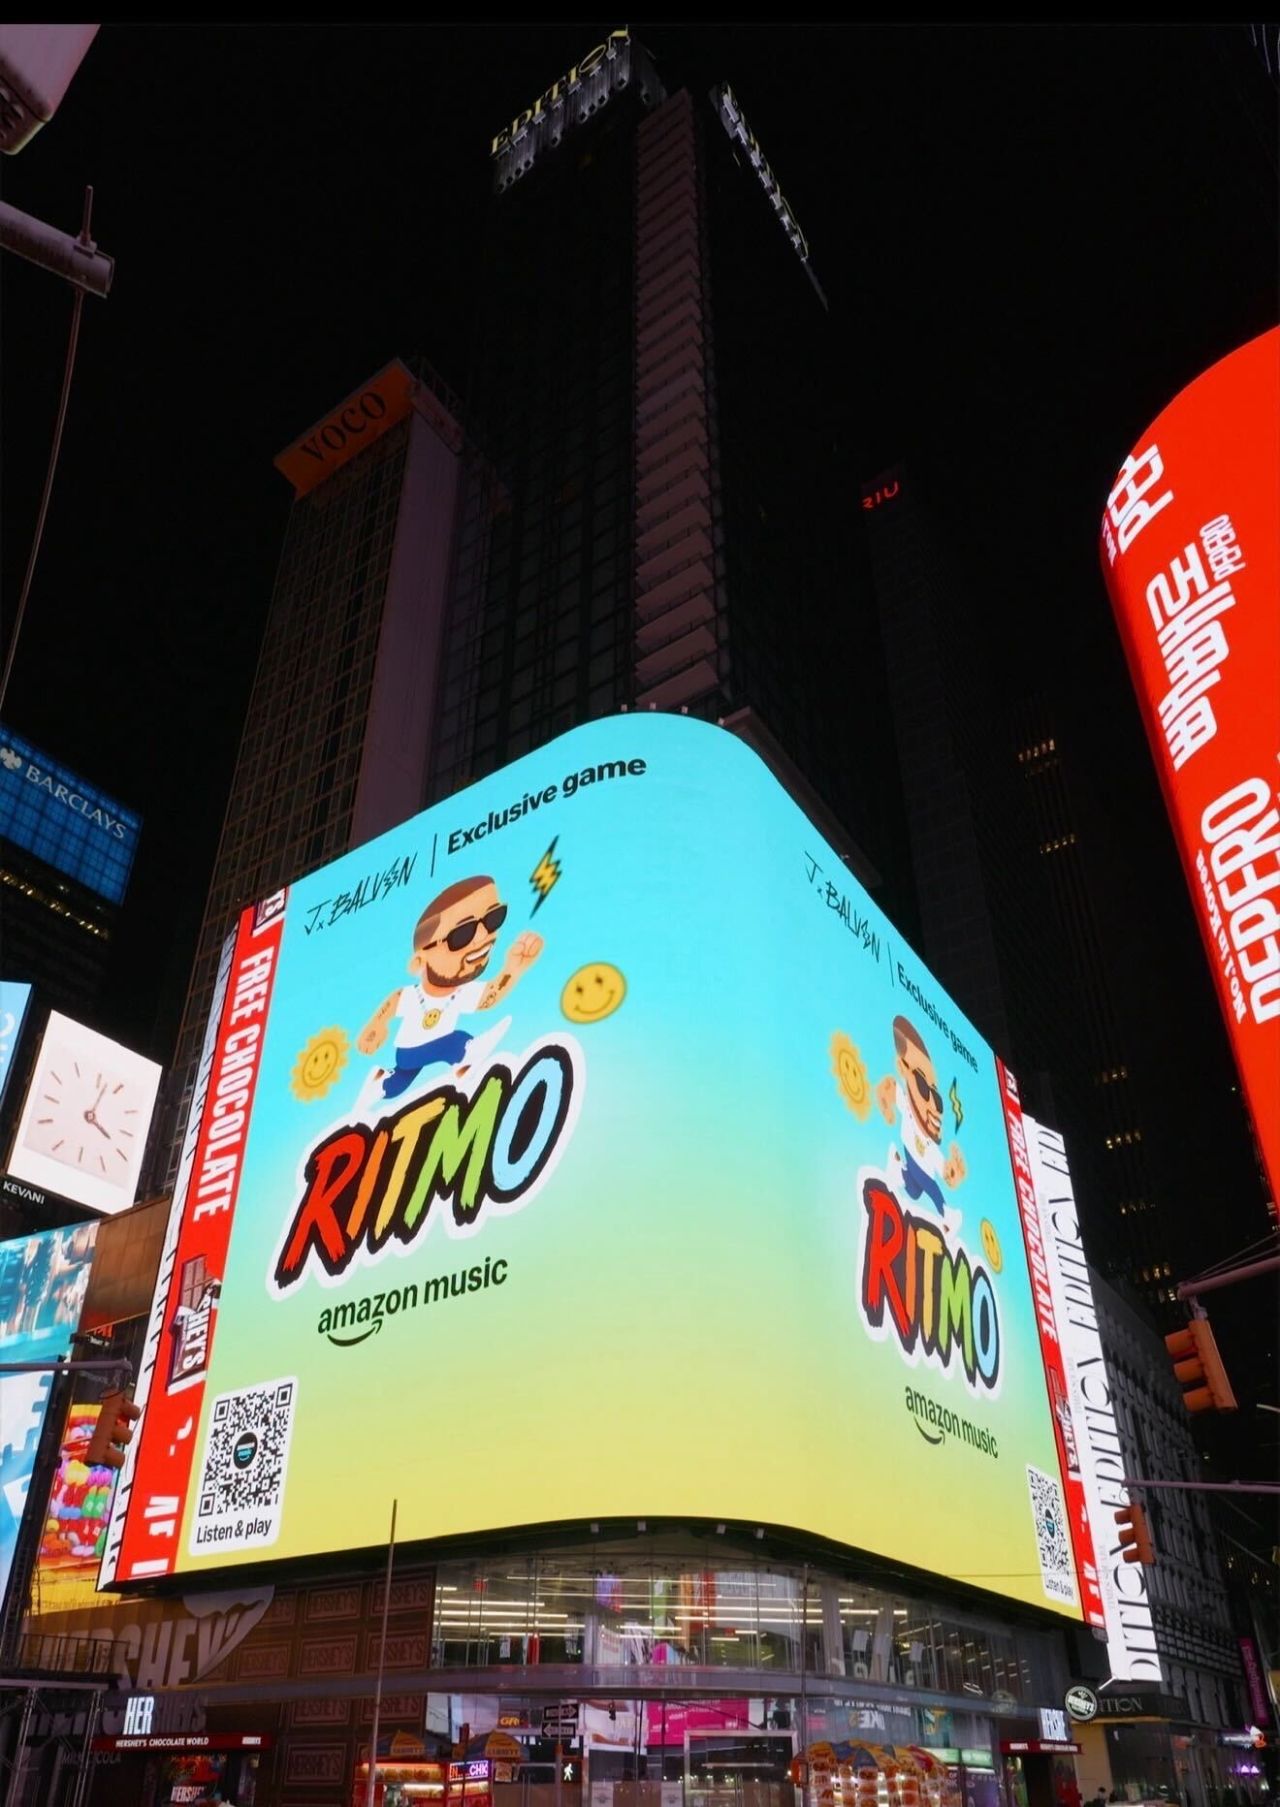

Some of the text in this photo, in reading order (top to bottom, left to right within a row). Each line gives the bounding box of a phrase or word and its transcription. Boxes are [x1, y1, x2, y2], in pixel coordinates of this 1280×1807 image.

[25, 764, 127, 839] BARCLAYS
[447, 758, 647, 855] Exclusive game
[897, 961, 979, 1073] Exclusive game
[193, 945, 274, 1223] FREE CHOCOLATE
[3, 1181, 45, 1204] KEVANI
[274, 1044, 574, 1290] RITMO
[317, 1256, 509, 1335] amazon music
[862, 1178, 999, 1389] RITMO
[1018, 1178, 1058, 1344] CHOCOLATE
[905, 1385, 999, 1458] amazon music
[196, 1517, 272, 1545] Listen & play
[149, 1736, 185, 1747] CHOCOLATE
[186, 1736, 209, 1746] WORLD
